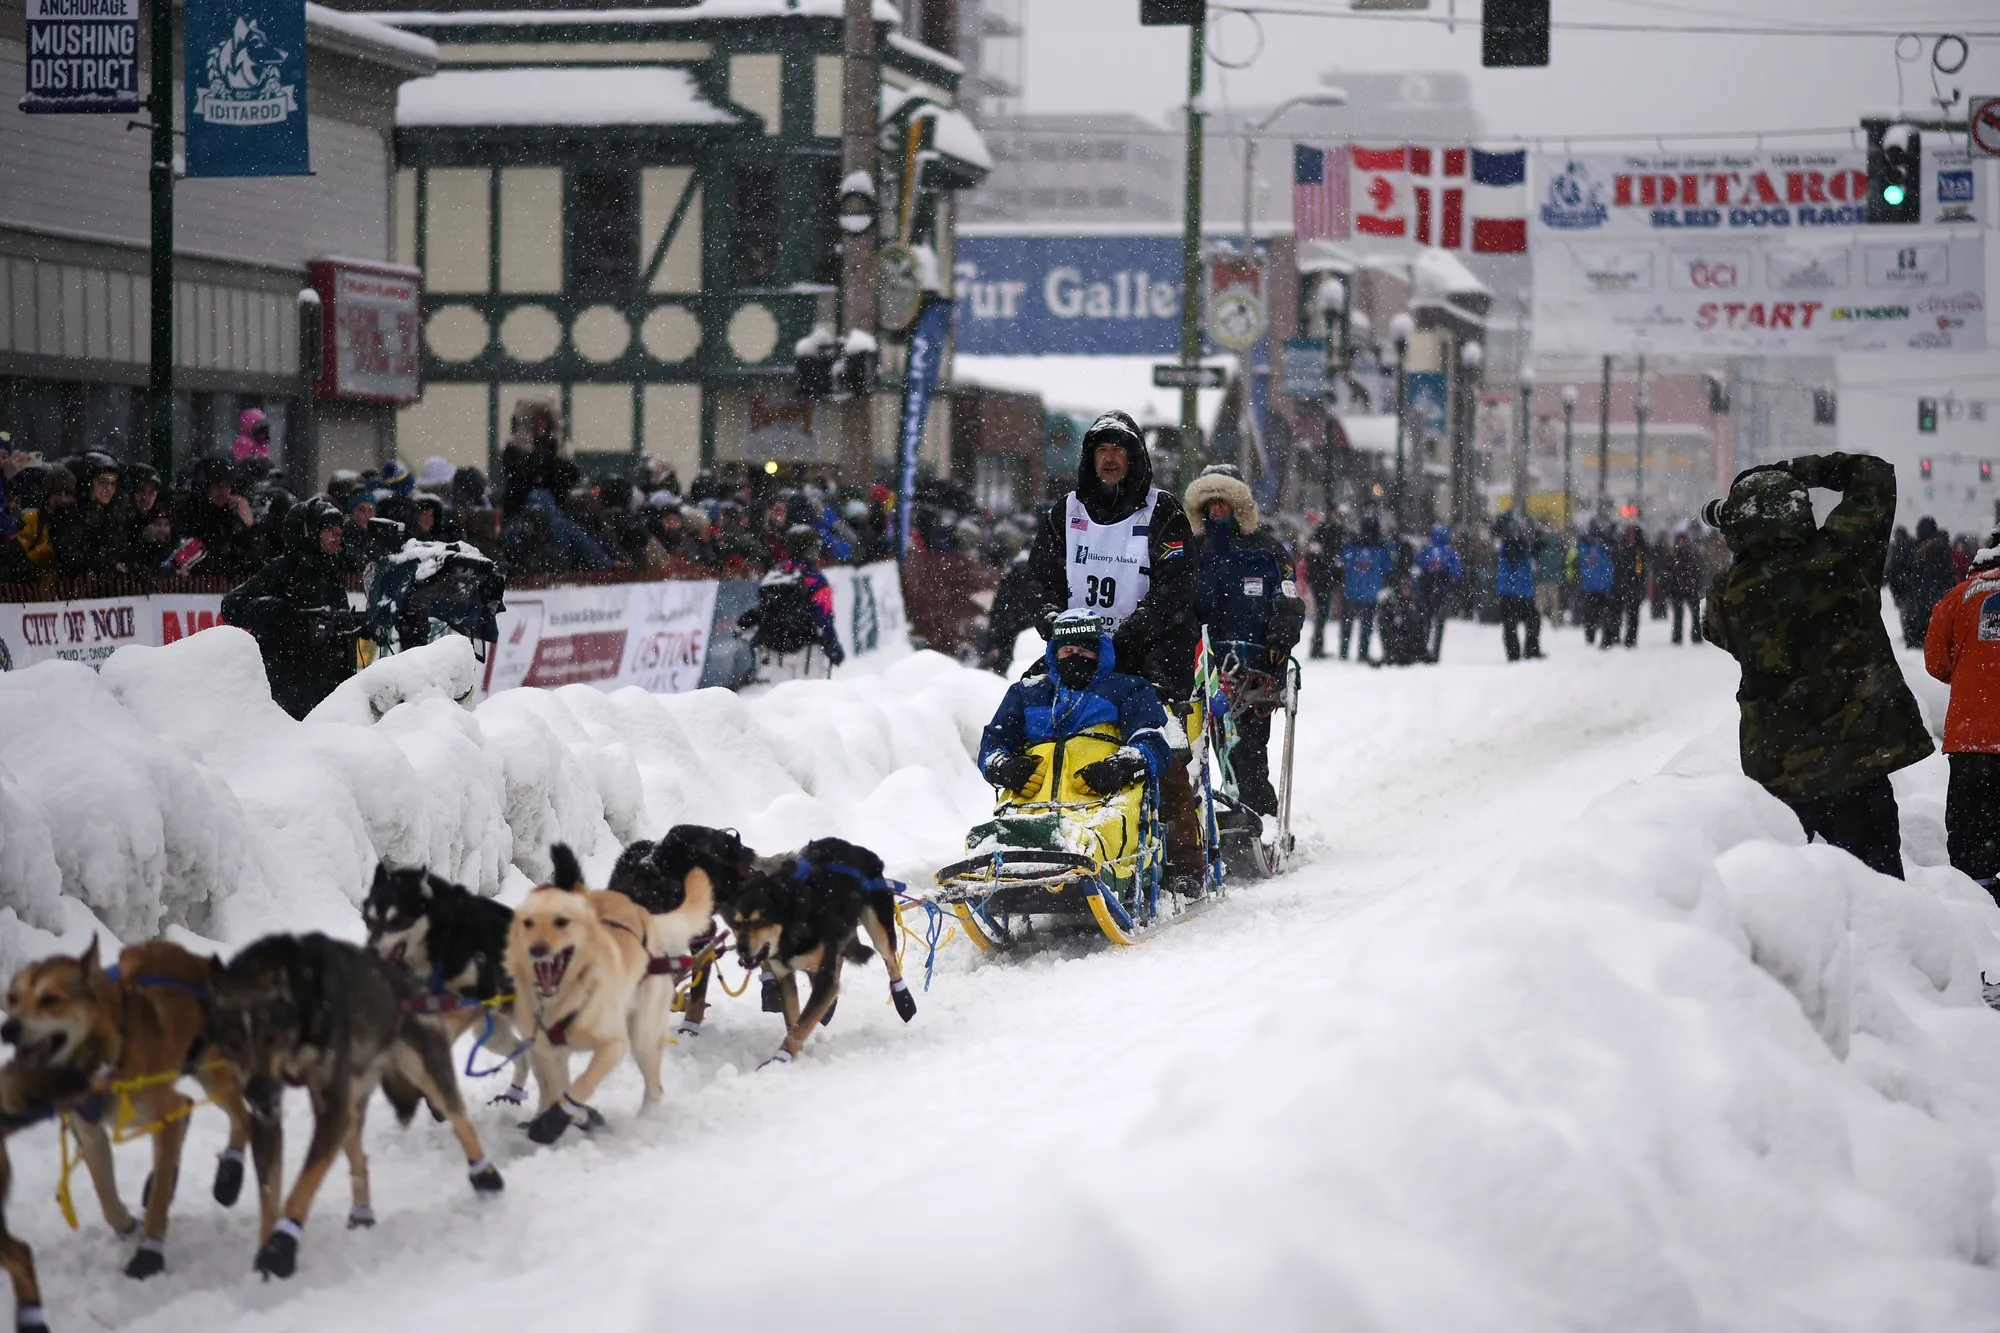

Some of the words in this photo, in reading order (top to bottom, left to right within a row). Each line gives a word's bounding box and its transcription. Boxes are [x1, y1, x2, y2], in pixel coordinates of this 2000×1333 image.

[39, 0, 128, 16] ANCHORAGE
[31, 25, 135, 56] MUSHING
[31, 59, 135, 90] DISTRICT
[209, 102, 281, 121] IDITAROD
[1613, 169, 1868, 207] IDITARO
[1729, 207, 1790, 226] DOG
[1044, 266, 1183, 318] Galle
[1695, 301, 1823, 331] START
[1088, 552, 1114, 564] Hilcorp
[1114, 554, 1138, 564] Alaska
[1085, 575, 1116, 608] 39
